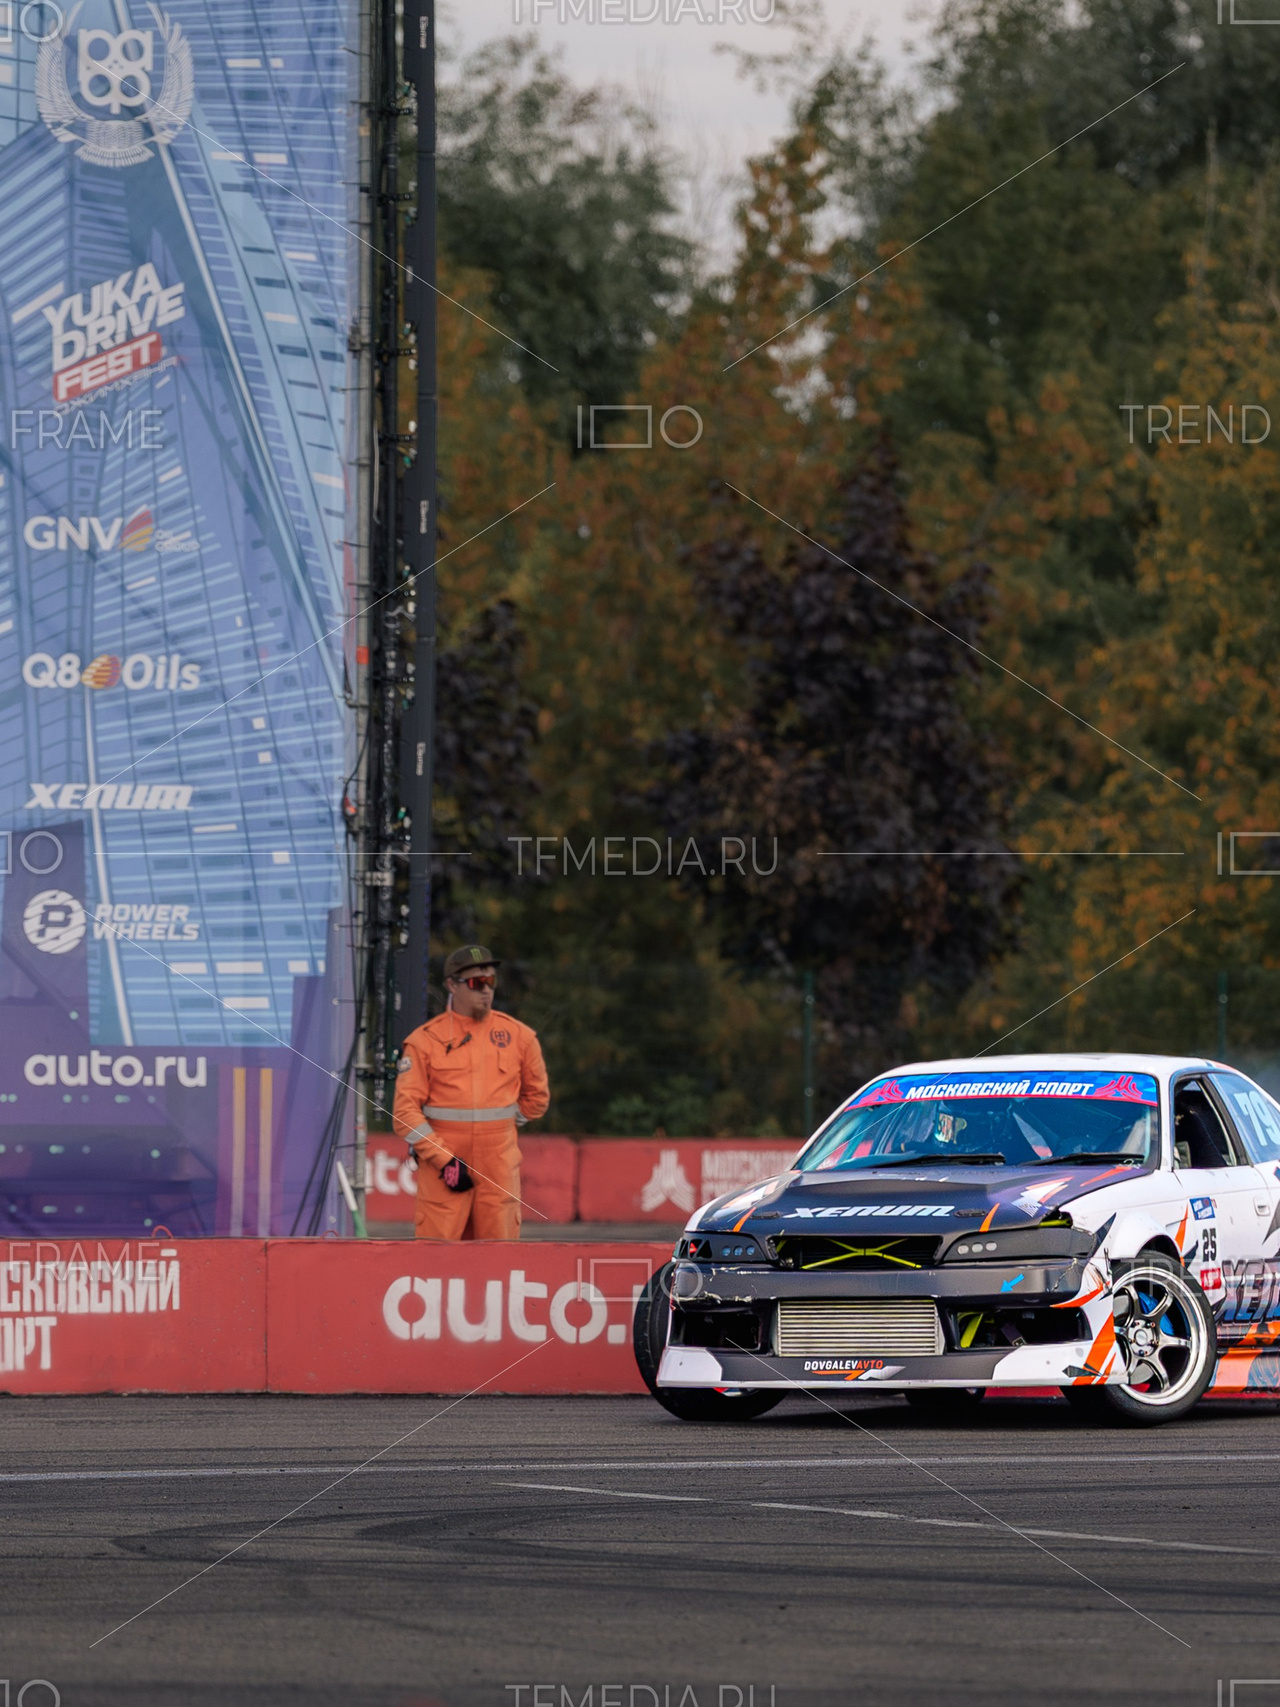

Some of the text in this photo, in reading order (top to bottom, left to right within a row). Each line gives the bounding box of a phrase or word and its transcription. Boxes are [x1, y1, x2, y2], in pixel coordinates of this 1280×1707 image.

[42, 262, 162, 336] YUKA
[53, 282, 185, 373] DRIVE
[57, 333, 158, 401] FEST
[23, 515, 123, 551] GNV
[22, 652, 201, 690] Q8 Oils
[24, 783, 195, 811] XENUM
[95, 903, 190, 922] POWER
[92, 922, 200, 940] WHEELS
[23, 1048, 208, 1088] auto.ru
[905, 1079, 1095, 1100] МОСКОВСКИЙ СПОРТ
[781, 1205, 956, 1219] XENUM
[1202, 1228, 1217, 1262] 25
[803, 1359, 884, 1371] DOVGALEVAVTO
